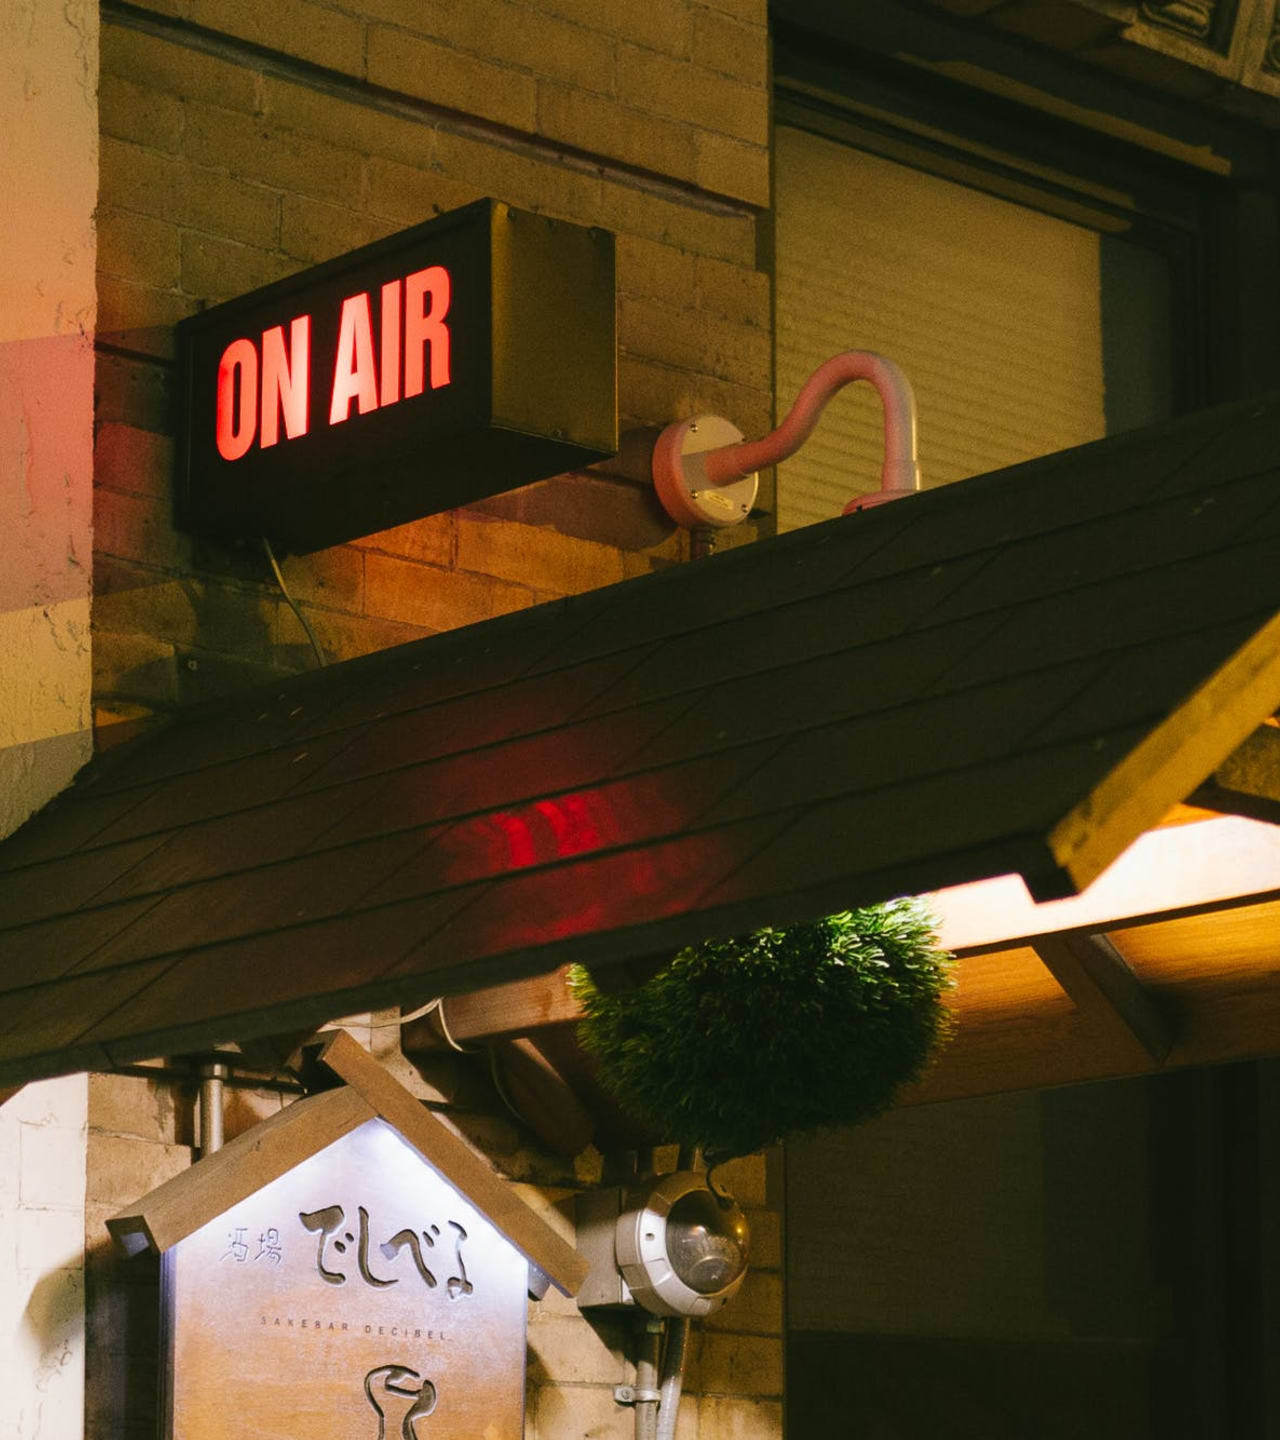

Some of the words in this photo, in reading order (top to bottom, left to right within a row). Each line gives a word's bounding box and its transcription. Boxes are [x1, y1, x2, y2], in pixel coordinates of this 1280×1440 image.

[216, 314, 311, 461] ON
[328, 265, 451, 426] AIR
[261, 1316, 348, 1331] SAKEBAR
[365, 1324, 446, 1340] DECIBEL
